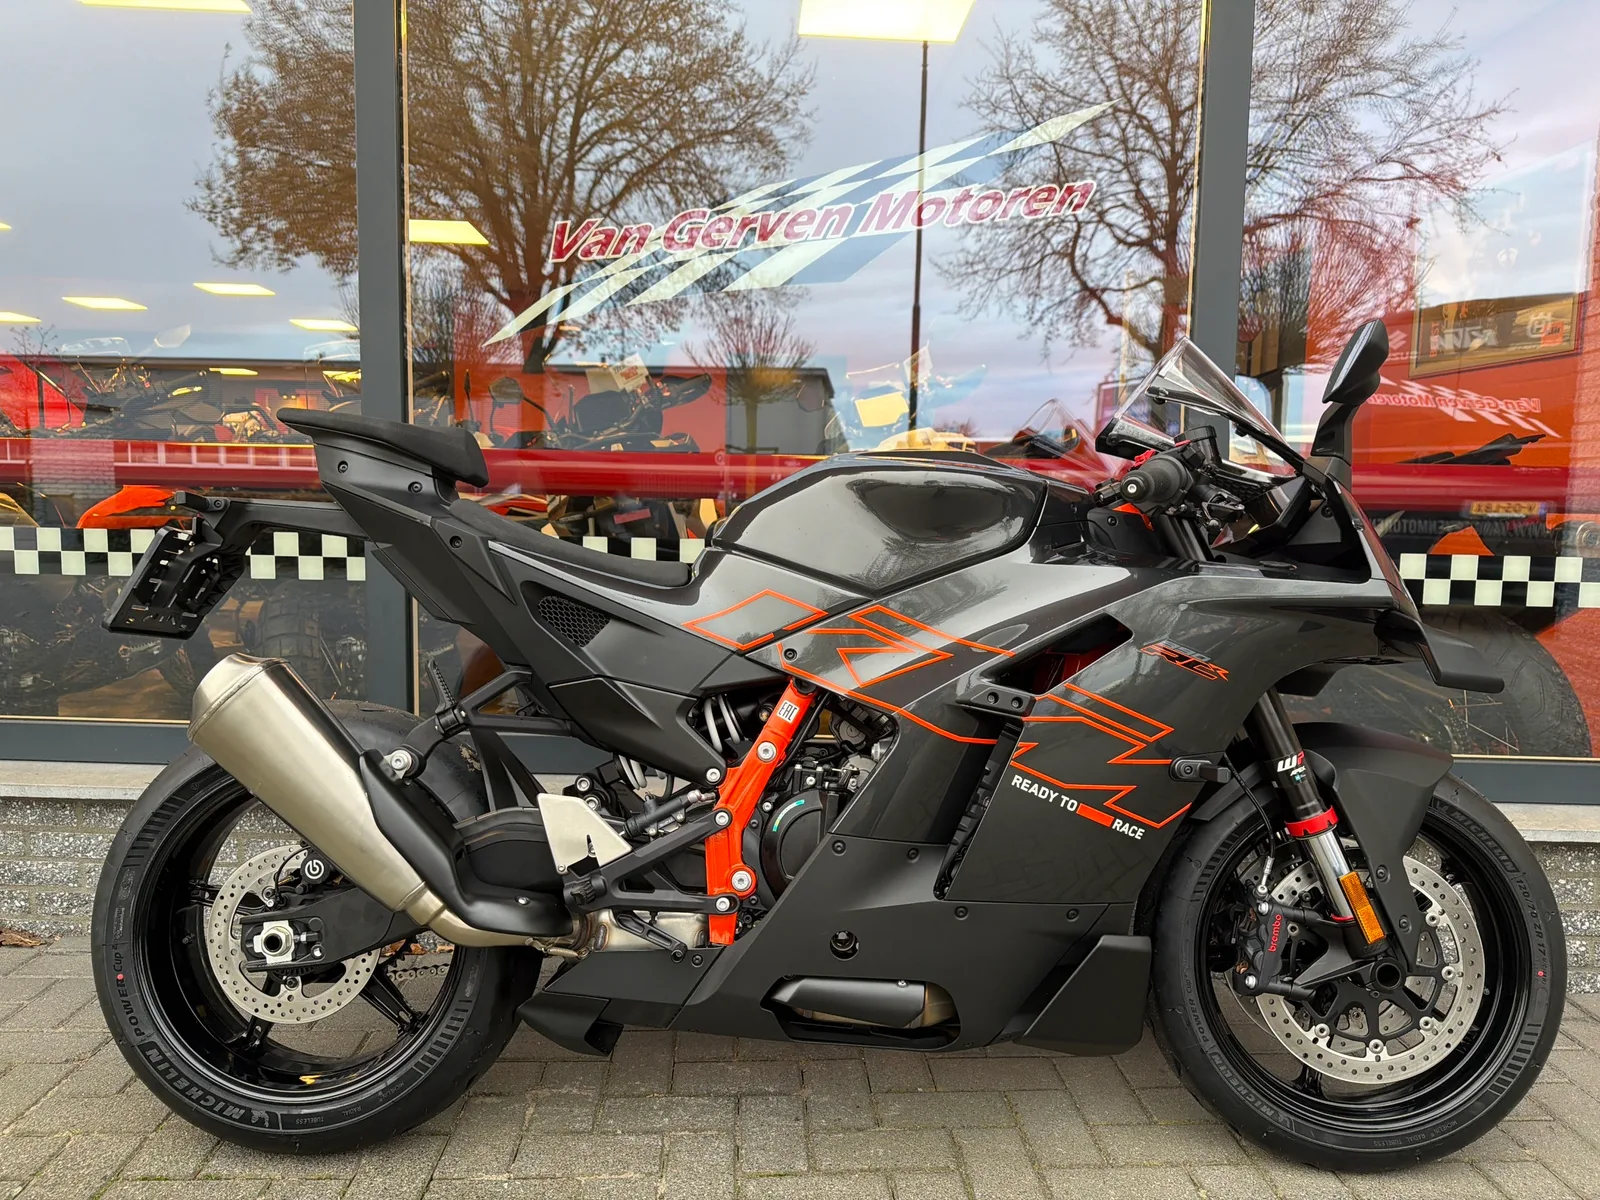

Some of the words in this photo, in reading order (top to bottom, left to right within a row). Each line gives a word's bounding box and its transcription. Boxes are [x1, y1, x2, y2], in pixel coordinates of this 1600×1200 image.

[551, 217, 653, 263] Van
[663, 203, 854, 253] Gerven
[859, 179, 1097, 233] Motoren
[1277, 750, 1305, 772] WP
[1011, 774, 1059, 803] READY
[1059, 795, 1078, 812] TO
[1112, 818, 1145, 840] RACE
[1450, 811, 1517, 874] MICHELIN
[1267, 914, 1282, 952] brembo
[1187, 998, 1210, 1043] POWER
[145, 1047, 246, 1120] MICHELIN
[1211, 1052, 1275, 1117] MICHELIN
